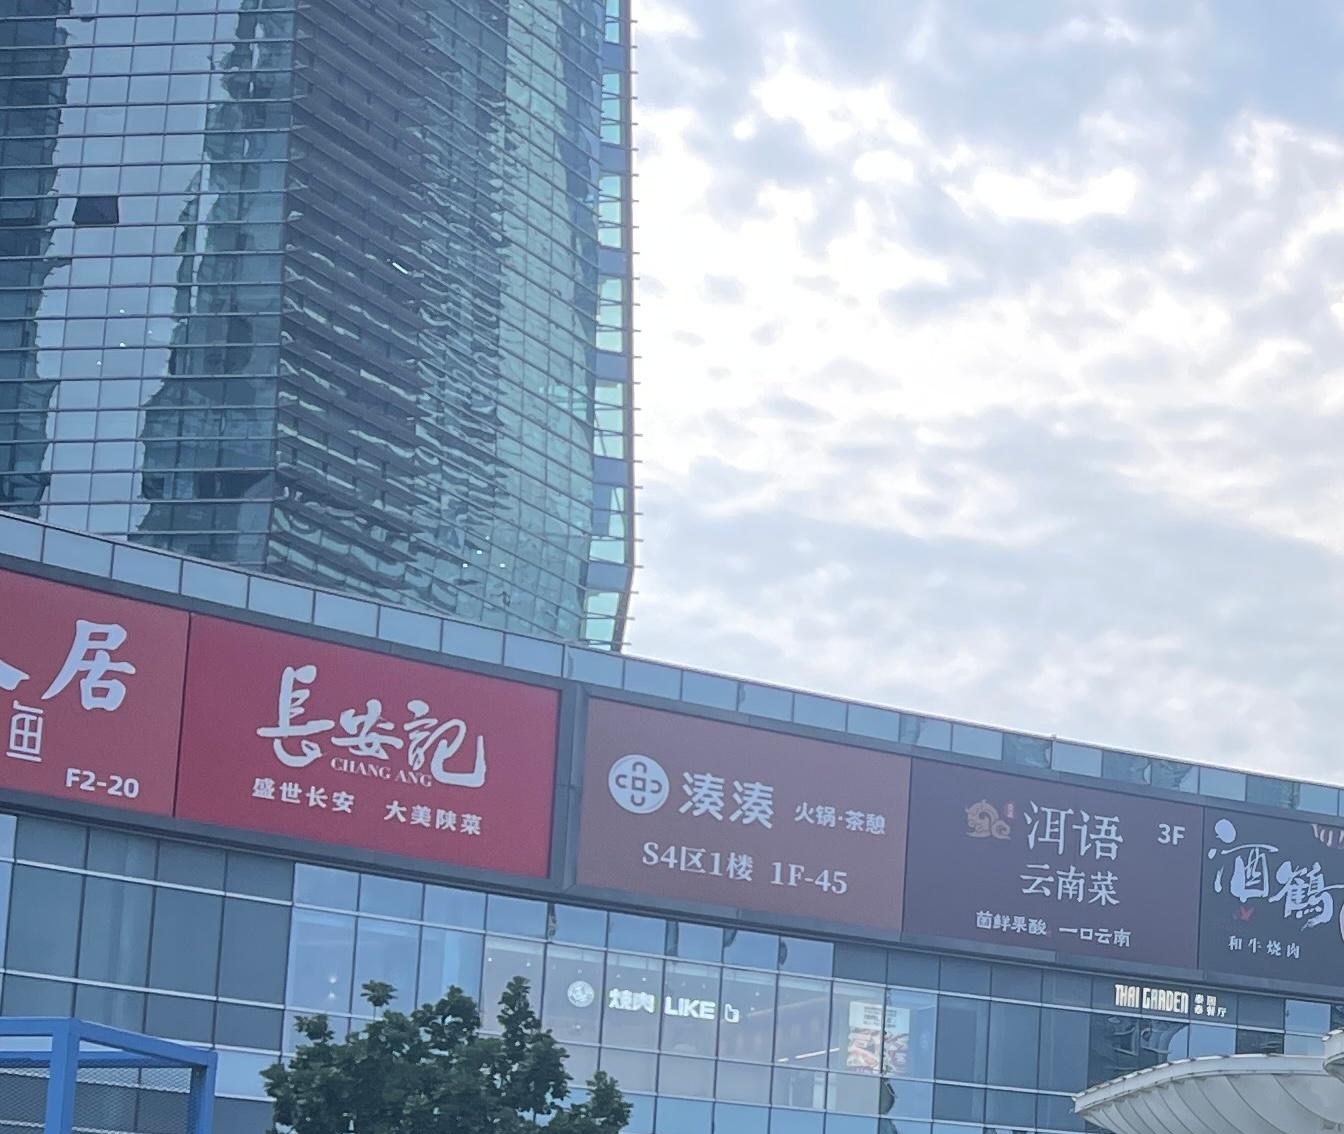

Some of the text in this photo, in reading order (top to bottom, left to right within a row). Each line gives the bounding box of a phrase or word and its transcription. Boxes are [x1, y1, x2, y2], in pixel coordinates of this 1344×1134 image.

[0, 620, 136, 711] 居
[66, 767, 139, 798] F2-20
[330, 757, 433, 788] CHANG ANG
[251, 777, 482, 836] 盛世长安 大美陕菜
[1025, 800, 1124, 862] 洱语
[1158, 823, 1185, 845] 3F
[642, 842, 848, 894] S4区1楼 1F-45
[1020, 863, 1120, 906] 云南菜
[976, 911, 1131, 948] 菌鲜果酸 一口云南
[664, 996, 716, 1019] LIKE
[1115, 983, 1189, 1014] THAI GARDEN
